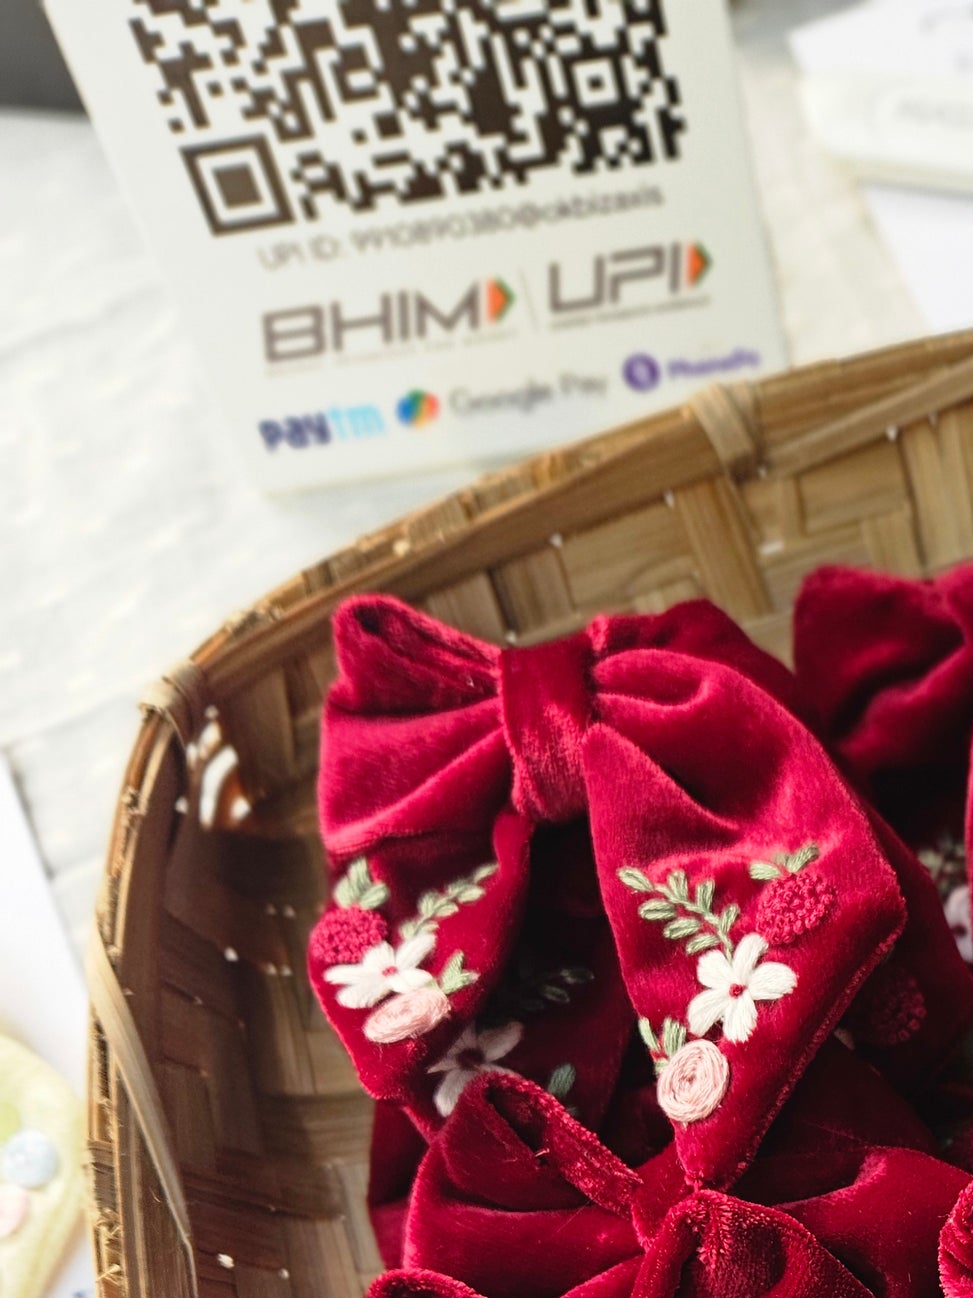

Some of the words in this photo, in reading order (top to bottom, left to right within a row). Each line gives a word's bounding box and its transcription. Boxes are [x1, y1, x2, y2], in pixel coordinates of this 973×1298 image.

[257, 238, 305, 272] UPI
[262, 280, 480, 363] BHIM
[548, 240, 682, 314] UPI
